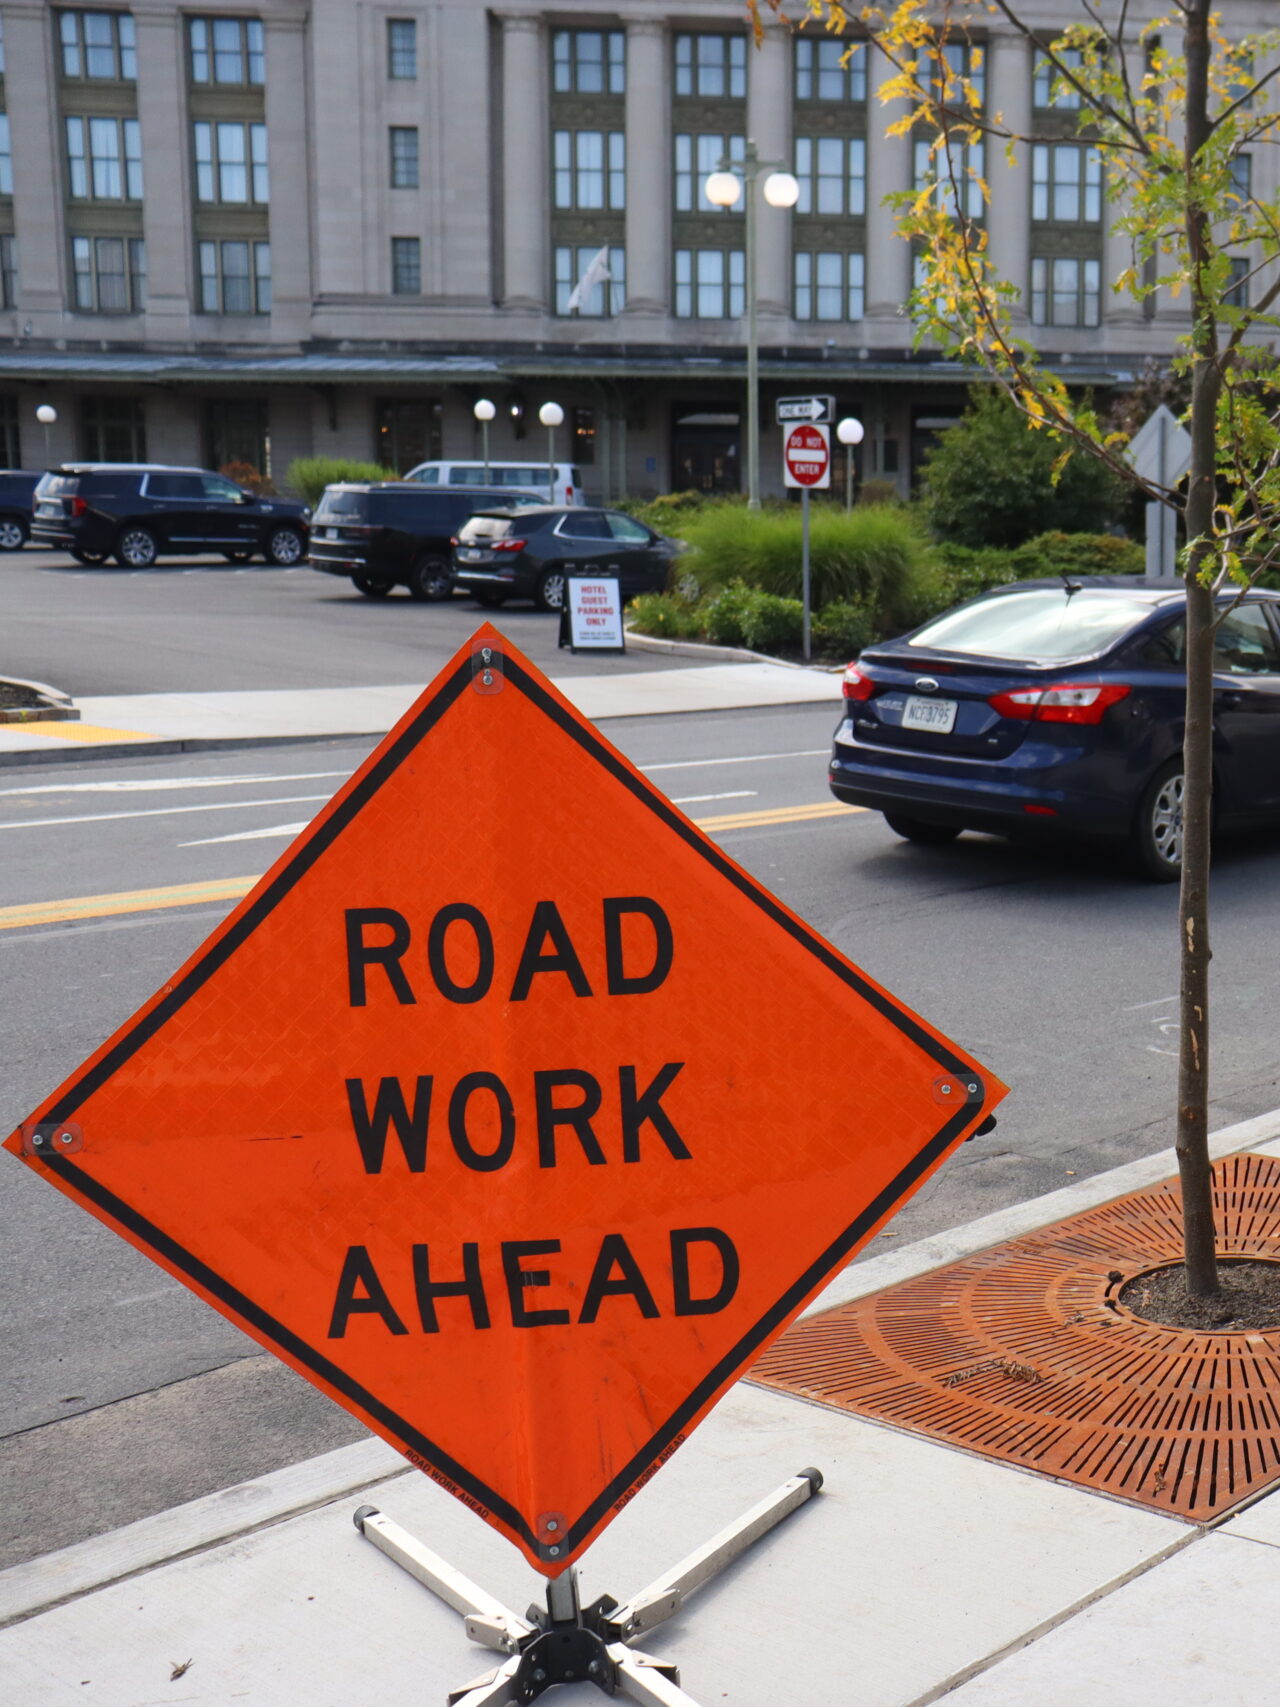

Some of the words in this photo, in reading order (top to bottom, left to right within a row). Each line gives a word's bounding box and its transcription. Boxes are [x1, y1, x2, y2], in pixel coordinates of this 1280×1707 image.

[790, 435, 802, 447] DO
[806, 437, 821, 448] NOT
[794, 463, 819, 475] ENTER
[581, 585, 607, 594] HOTEL
[581, 596, 608, 604] GUEST
[577, 607, 614, 615] PARKING
[586, 617, 606, 626] ONLY
[345, 896, 674, 1007] ROAD
[345, 1062, 693, 1174] WORK
[328, 1226, 740, 1339] AHEAD
[613, 1487, 637, 1512] ROAD
[635, 1462, 660, 1492] WORK
[659, 1433, 687, 1466] AHEAD
[404, 1449, 430, 1475] ROAD
[431, 1467, 459, 1494] WORK
[458, 1491, 490, 1519] AHEAD
